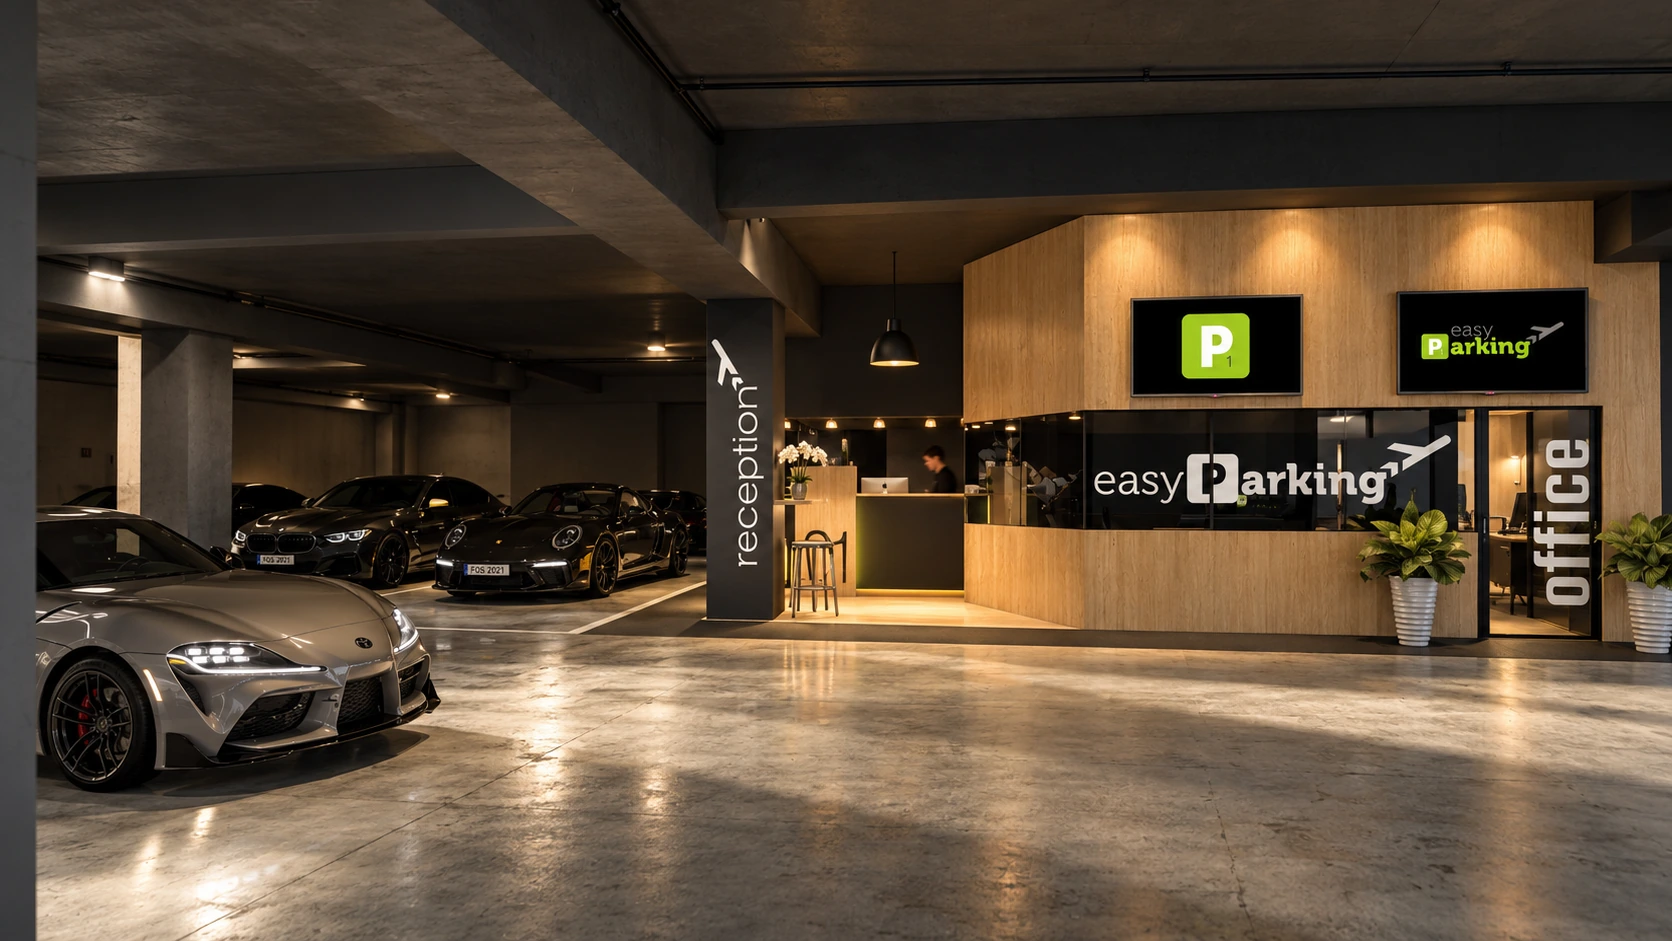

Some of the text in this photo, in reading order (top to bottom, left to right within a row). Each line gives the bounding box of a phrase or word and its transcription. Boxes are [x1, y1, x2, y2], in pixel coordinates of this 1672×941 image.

[1201, 325, 1233, 368] P
[1428, 337, 1530, 359] Parking
[1451, 325, 1493, 340] easy
[732, 386, 764, 567] reception
[1533, 439, 1590, 606] office
[470, 566, 504, 574] FOS 2021
